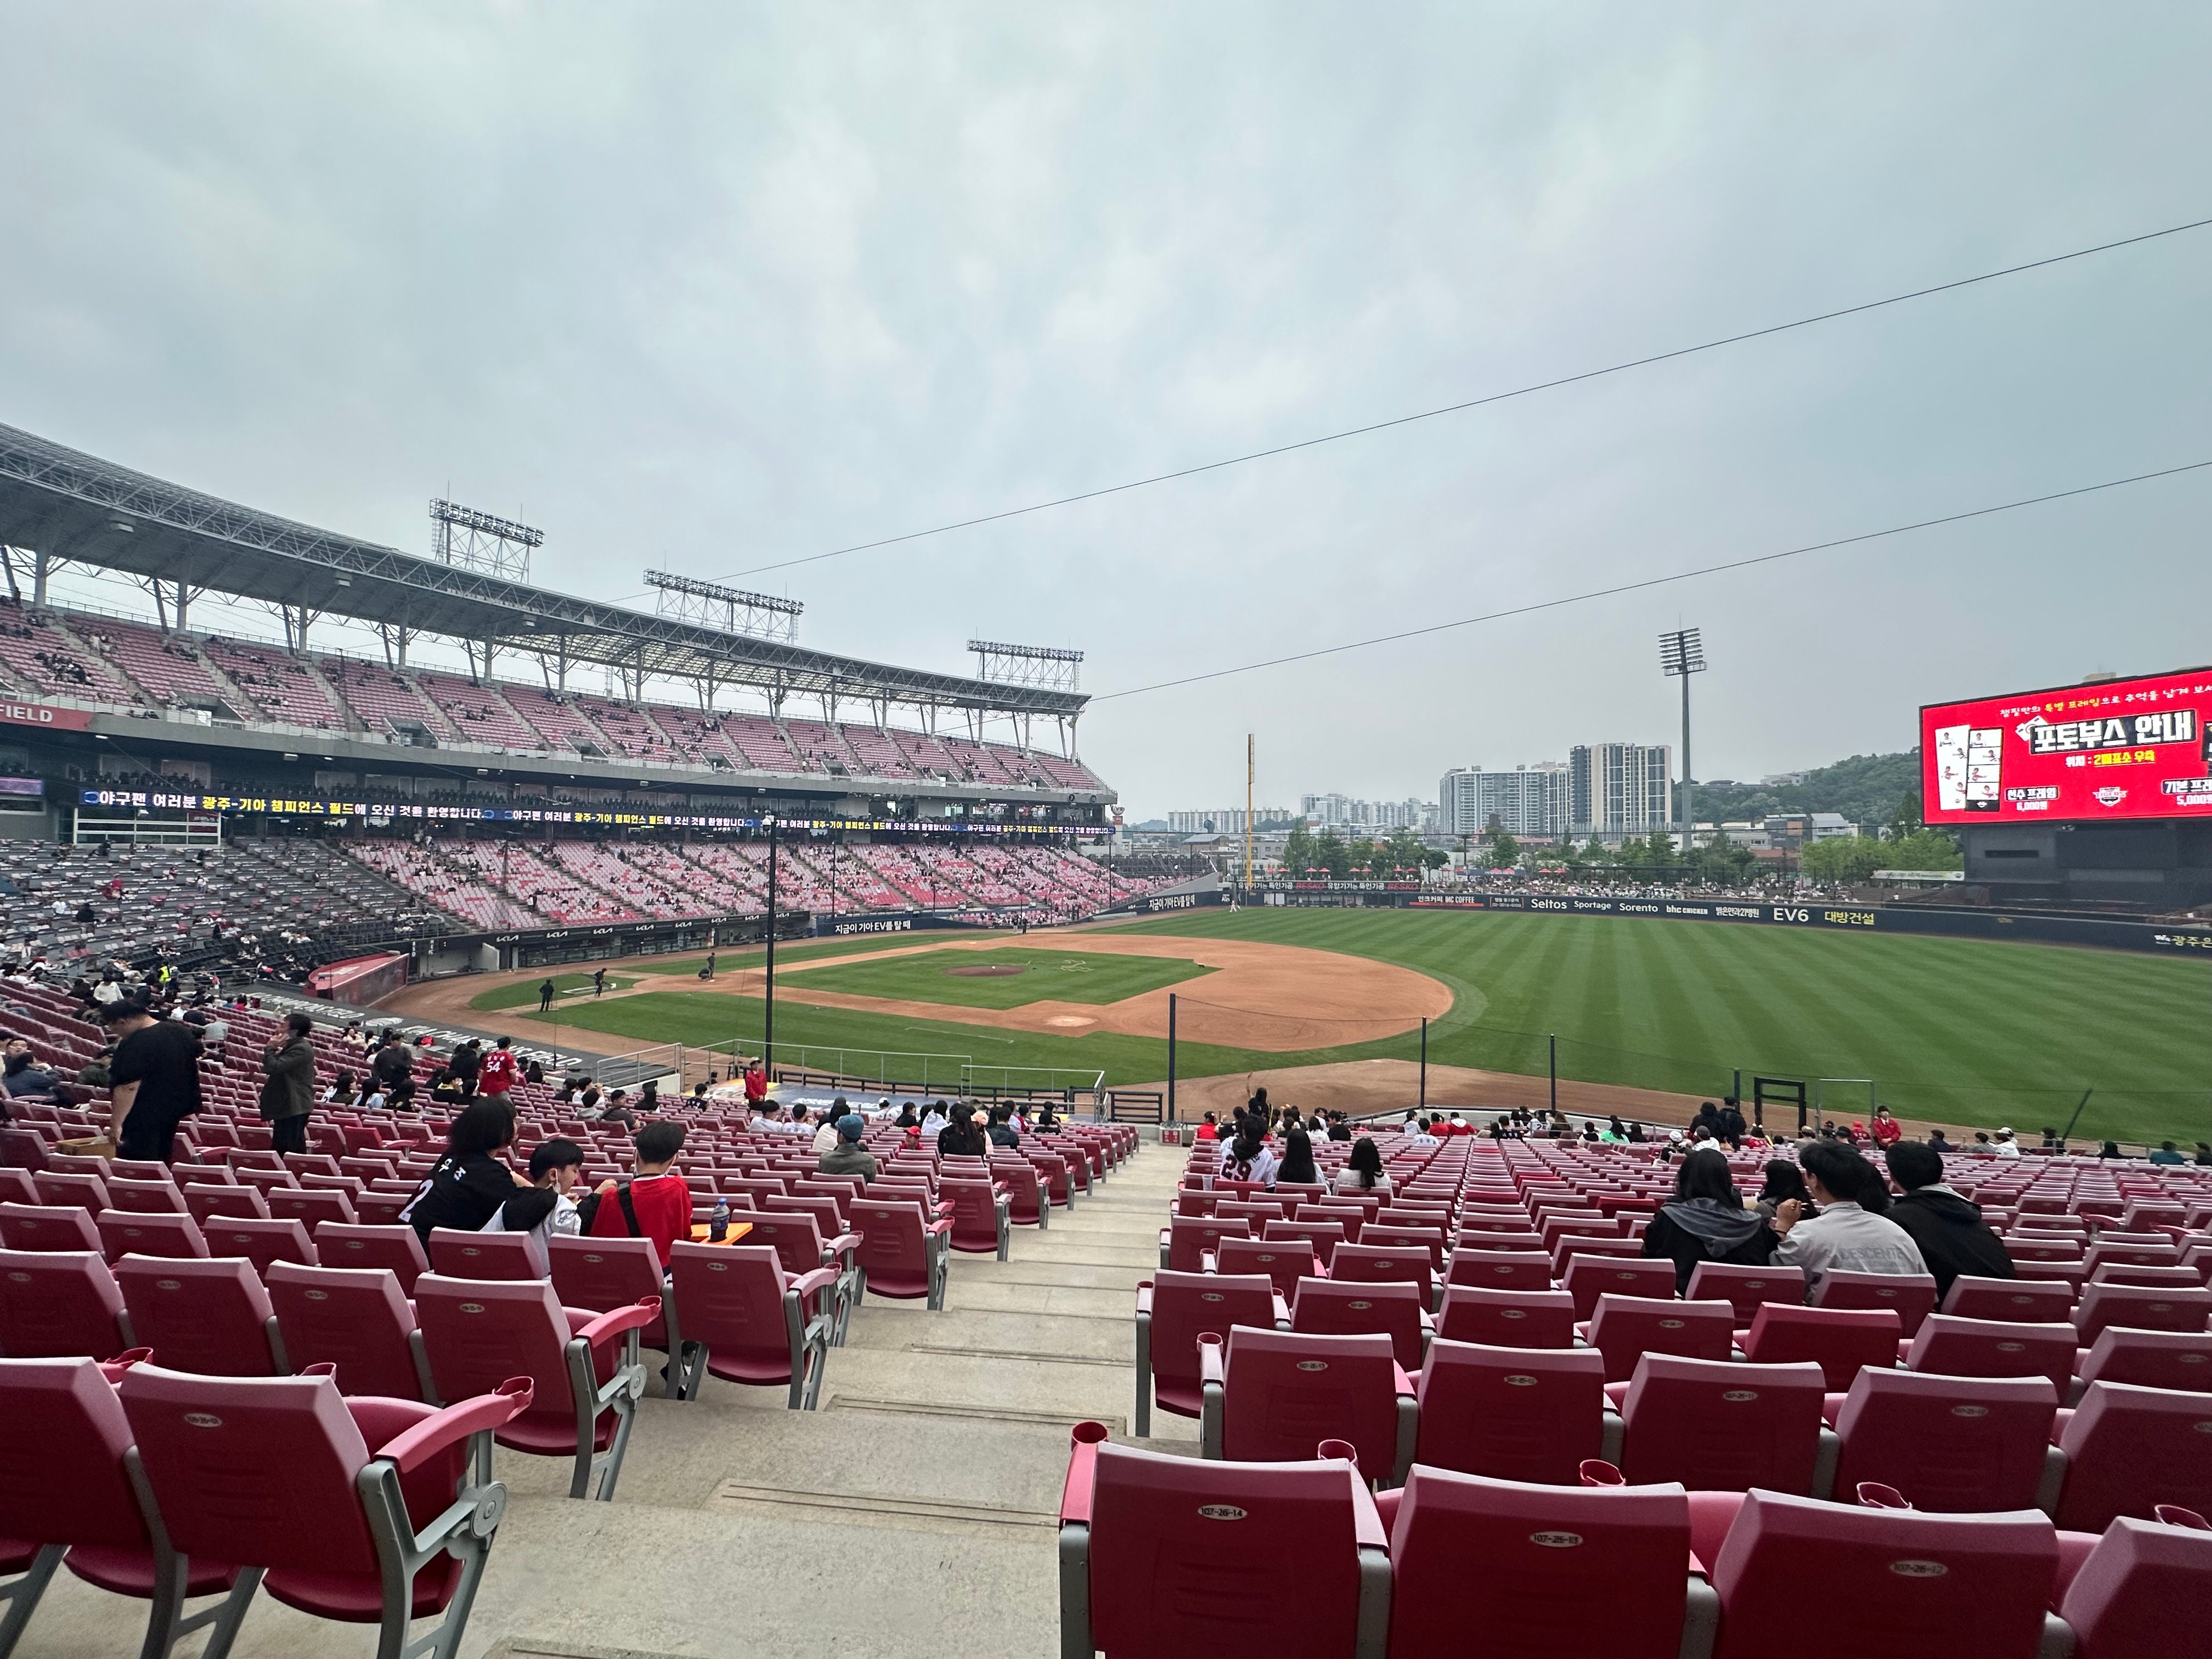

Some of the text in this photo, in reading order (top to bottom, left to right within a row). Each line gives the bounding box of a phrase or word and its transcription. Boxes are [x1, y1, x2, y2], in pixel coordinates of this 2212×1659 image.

[2044, 702, 2064, 712] 특별
[2068, 696, 2121, 709] 프레임으로
[2124, 689, 2159, 702] 추억을
[2163, 687, 2189, 698] 남겨
[2034, 711, 2192, 753] 포토부스 안내
[2065, 755, 2085, 768] 위치
[2094, 753, 2132, 766] 2매표소
[2134, 750, 2155, 762] 우측
[2164, 780, 2187, 793] 기본
[2007, 788, 2056, 800] 선수 프레임
[2092, 790, 2128, 798] TIGERS
[99, 791, 485, 819] 야구팬 여러분 광주-기아 챔피언스 필드에 오신 것을 환영합니다.
[2016, 800, 2047, 811] 6,000원
[513, 809, 541, 821] 야구팬
[544, 811, 572, 822] 여러분
[574, 812, 612, 823] 광주-기아
[615, 814, 646, 824] 챔피언스
[649, 814, 672, 825] 필드에
[674, 815, 689, 826] 오신
[789, 820, 810, 828] 여러분
[1149, 897, 1164, 911] 지금이
[1164, 896, 1174, 910] 기아
[1531, 898, 1658, 913] Seltos Sportage Sorento
[1666, 905, 1708, 915] bhc CHICKEN
[1716, 906, 1760, 918] 밝은안과21병원
[1773, 908, 1809, 922] EV6
[1825, 911, 1875, 926] 대방건설
[835, 923, 857, 934] 지금이
[859, 922, 873, 933] 기아
[874, 921, 893, 931] EV를
[903, 919, 911, 929] 때
[496, 934, 519, 943] KIA
[546, 930, 568, 939] KIA
[487, 1061, 501, 1073] 54
[1221, 1154, 1252, 1182] 29
[1200, 1507, 1243, 1518] 107-26-14
